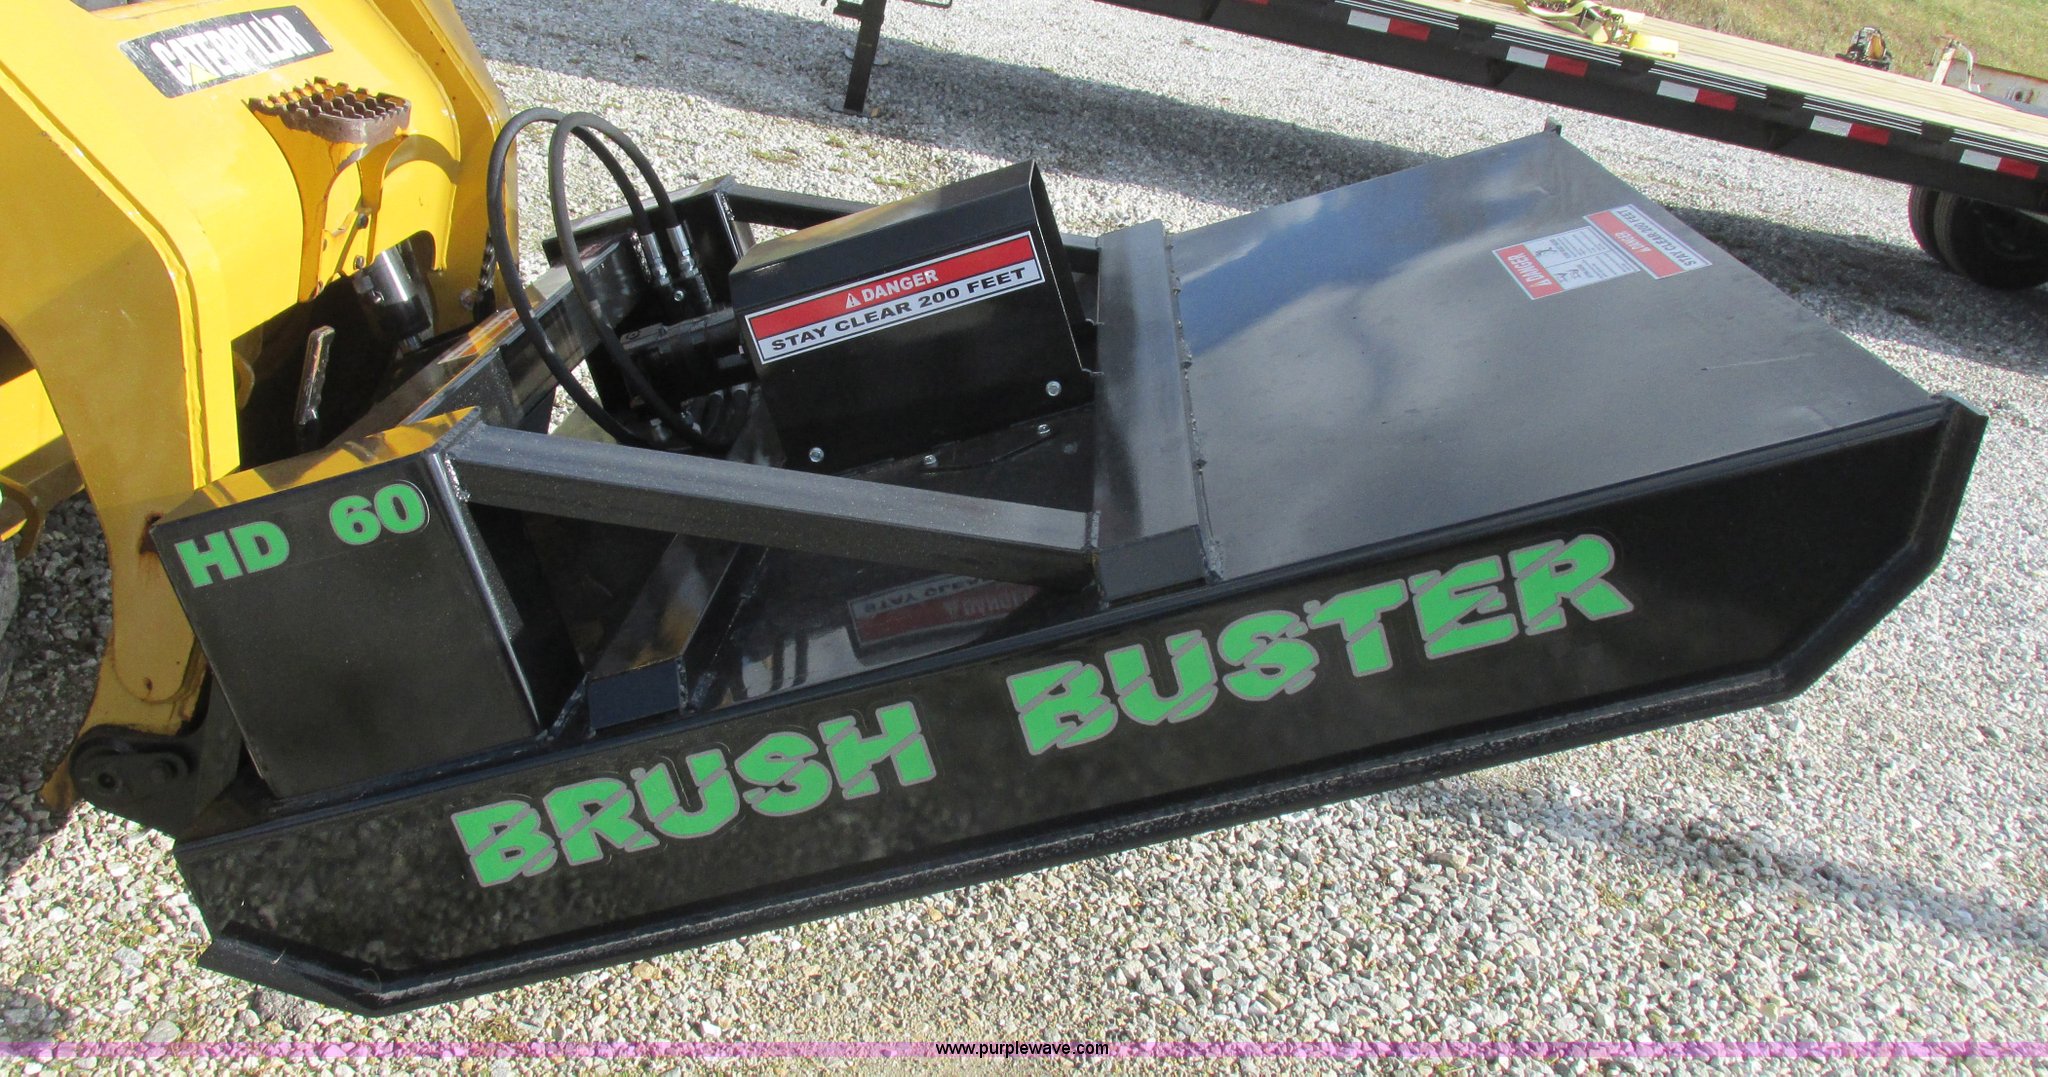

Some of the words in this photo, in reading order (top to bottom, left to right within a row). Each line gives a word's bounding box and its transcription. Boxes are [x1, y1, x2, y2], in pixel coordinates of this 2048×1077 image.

[151, 15, 315, 87] CATERPILLAR
[1616, 209, 1636, 223] FEET
[1633, 222, 1650, 234] 200
[1614, 230, 1642, 250] DANGER
[1646, 232, 1674, 251] CLEAR
[1506, 252, 1546, 284] DANGER
[1671, 249, 1697, 267] STAY
[861, 269, 939, 303] DANGER
[771, 326, 828, 351] STAY
[835, 301, 913, 332] CLEAR
[918, 287, 960, 309] 200
[967, 267, 1026, 294] FEET
[174, 521, 290, 588] HD
[329, 483, 426, 545] 60
[451, 701, 936, 887] BRUSH
[1006, 534, 1634, 756] BUSTER
